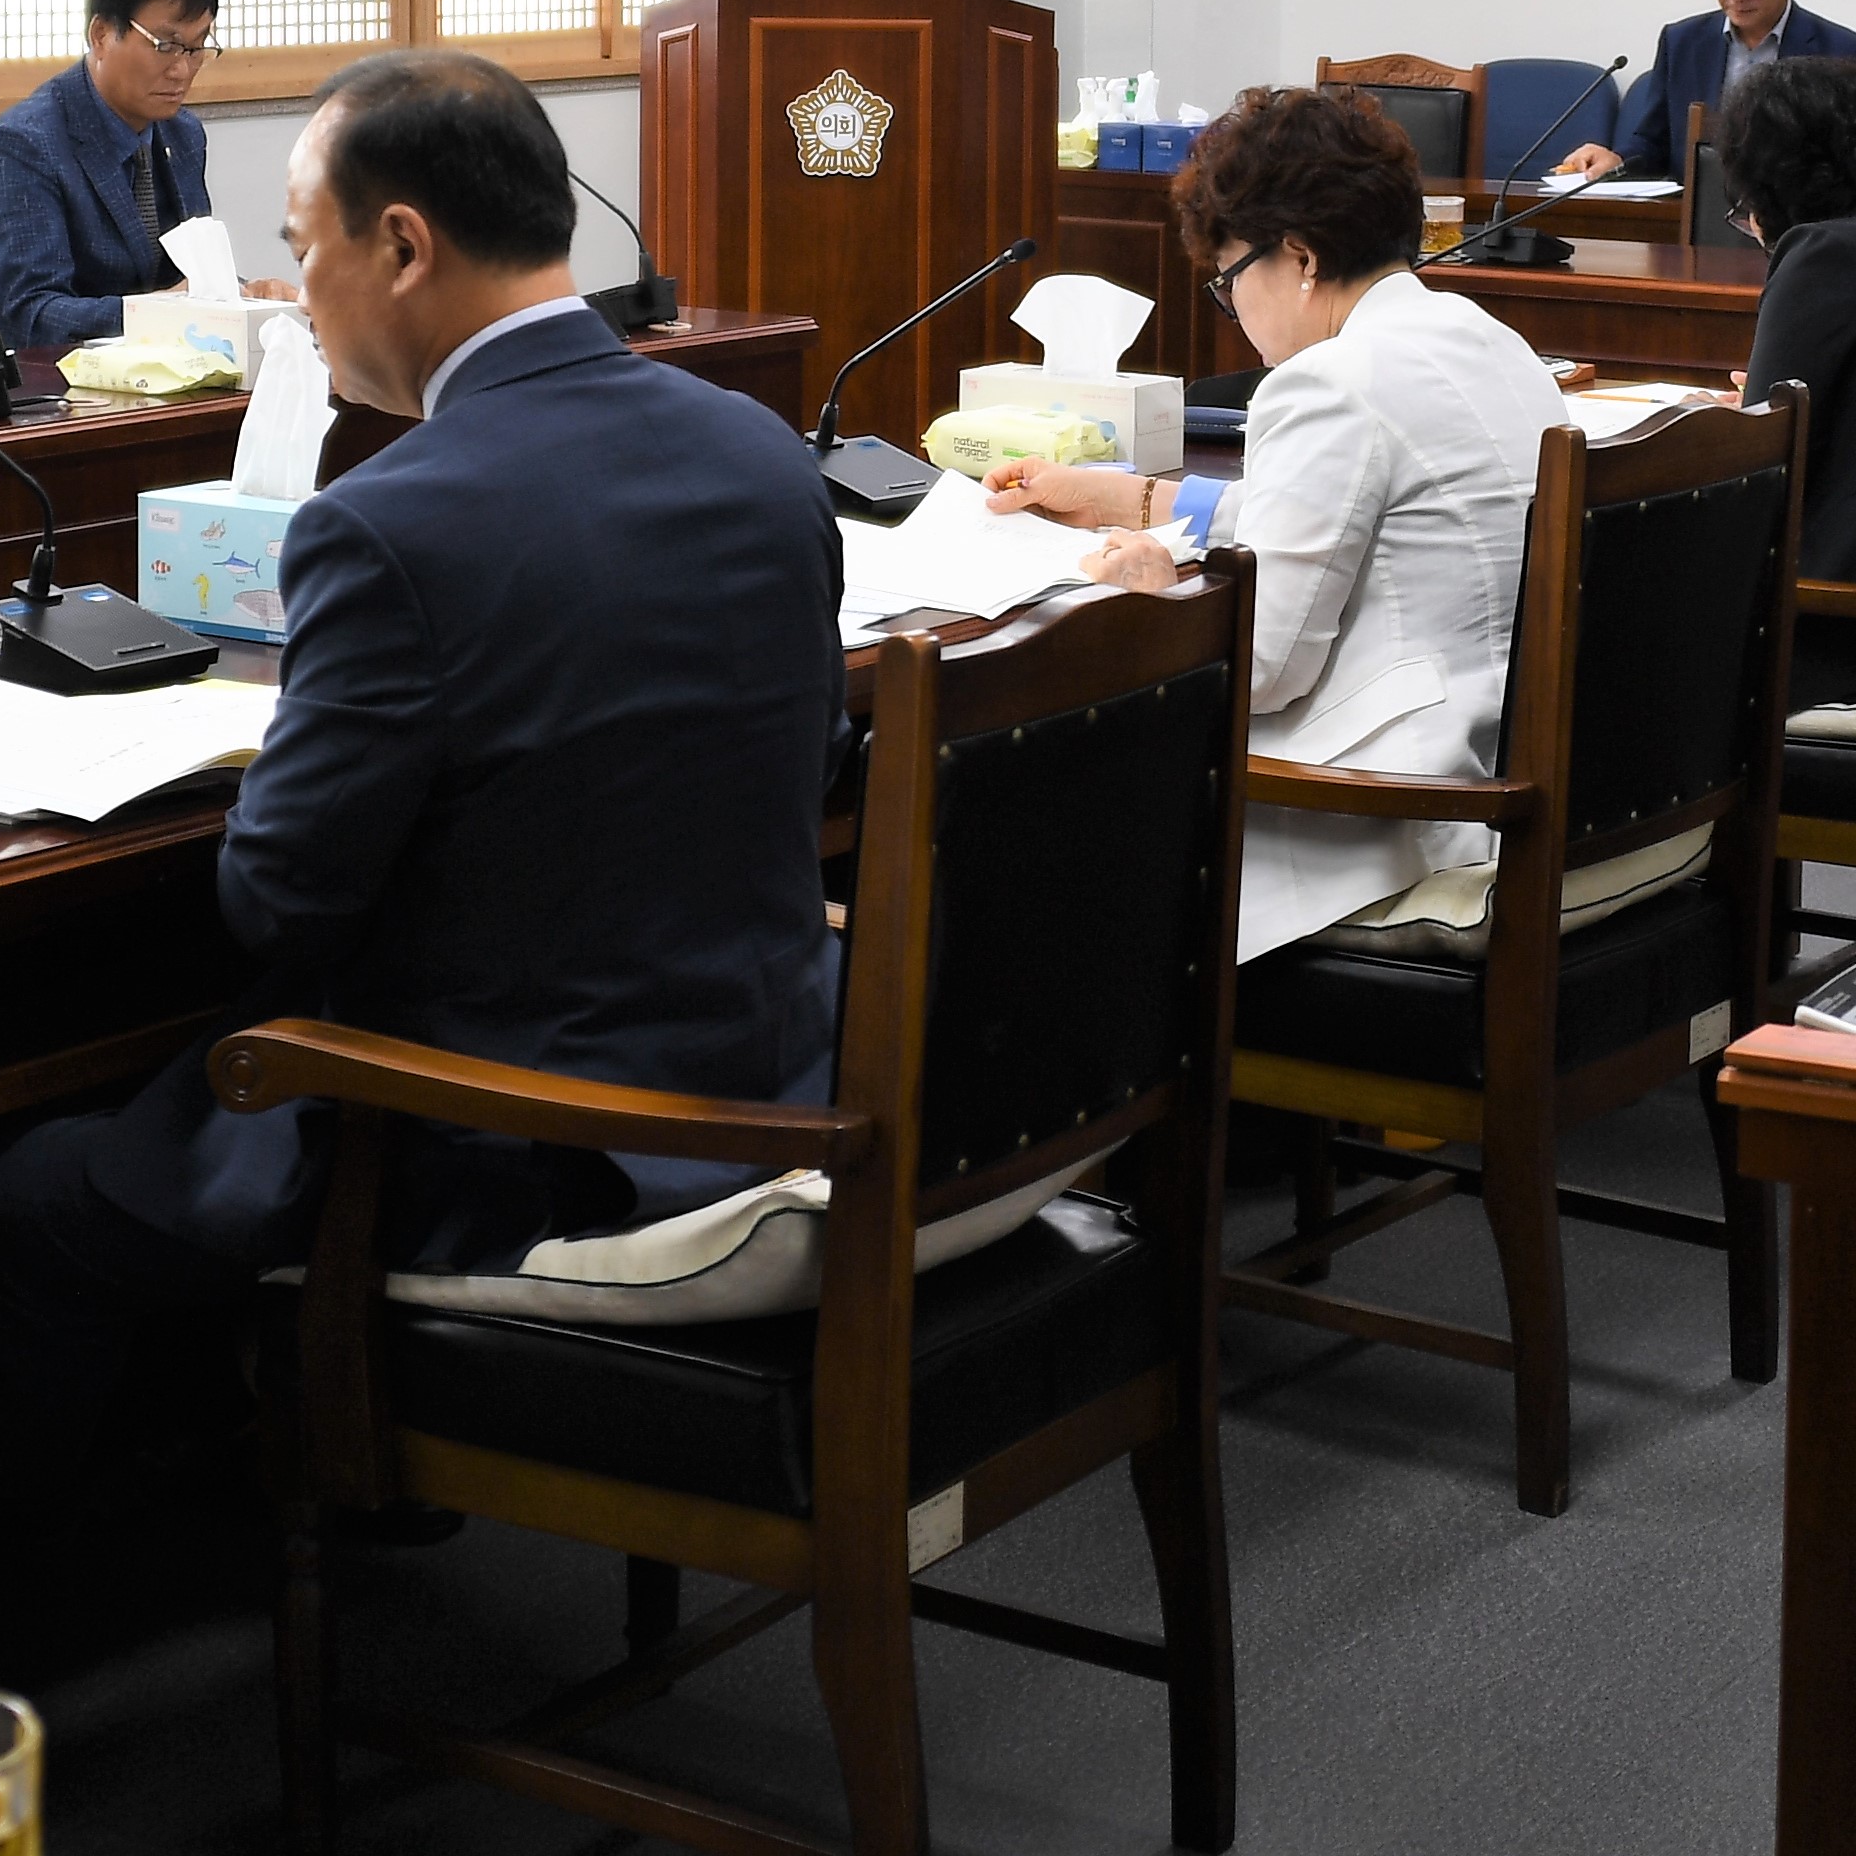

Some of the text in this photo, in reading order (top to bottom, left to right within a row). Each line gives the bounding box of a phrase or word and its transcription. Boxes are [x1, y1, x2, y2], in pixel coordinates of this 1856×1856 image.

[820, 113, 857, 139] 의회
[953, 437, 991, 449] natural
[954, 445, 993, 459] organic
